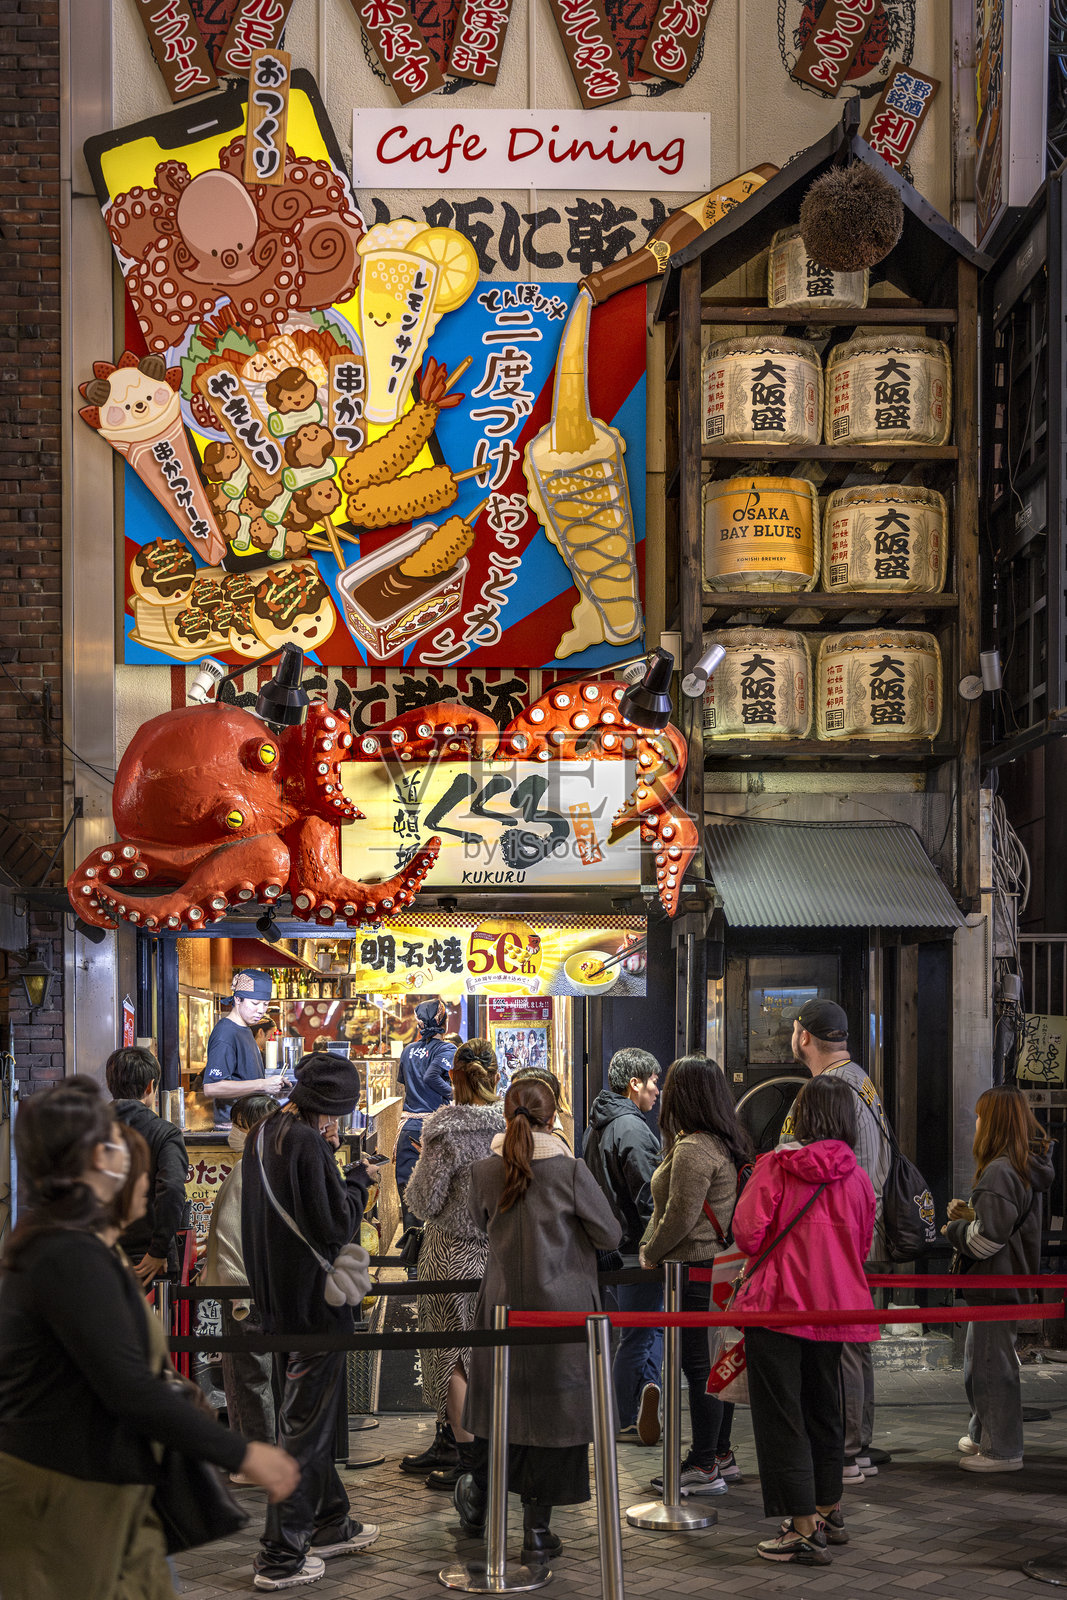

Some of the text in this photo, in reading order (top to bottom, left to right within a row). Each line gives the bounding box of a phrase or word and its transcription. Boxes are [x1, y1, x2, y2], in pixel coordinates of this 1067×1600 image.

[143, 0, 210, 92] イブルース
[254, 56, 287, 178] おつくり
[376, 124, 685, 174] Cafe Dining
[367, 197, 680, 275] 阪に乾
[806, 254, 835, 297] 阪盛
[388, 271, 428, 394] レモンサワー
[207, 370, 283, 475] やきとり
[334, 363, 366, 451] 串かつ
[751, 359, 787, 432] 大阪盛
[874, 358, 911, 430] 大阪盛
[152, 440, 210, 538] 串かつケーキ
[720, 525, 801, 541] BAY BLUES
[874, 508, 910, 580] 大阪盛
[740, 654, 777, 725] 大阪盛
[869, 654, 905, 725] 大阪盛
[423, 773, 570, 869] くくる
[461, 871, 526, 884] KUKURU
[361, 935, 463, 973] 明石焼
[716, 1352, 744, 1381] BIC
